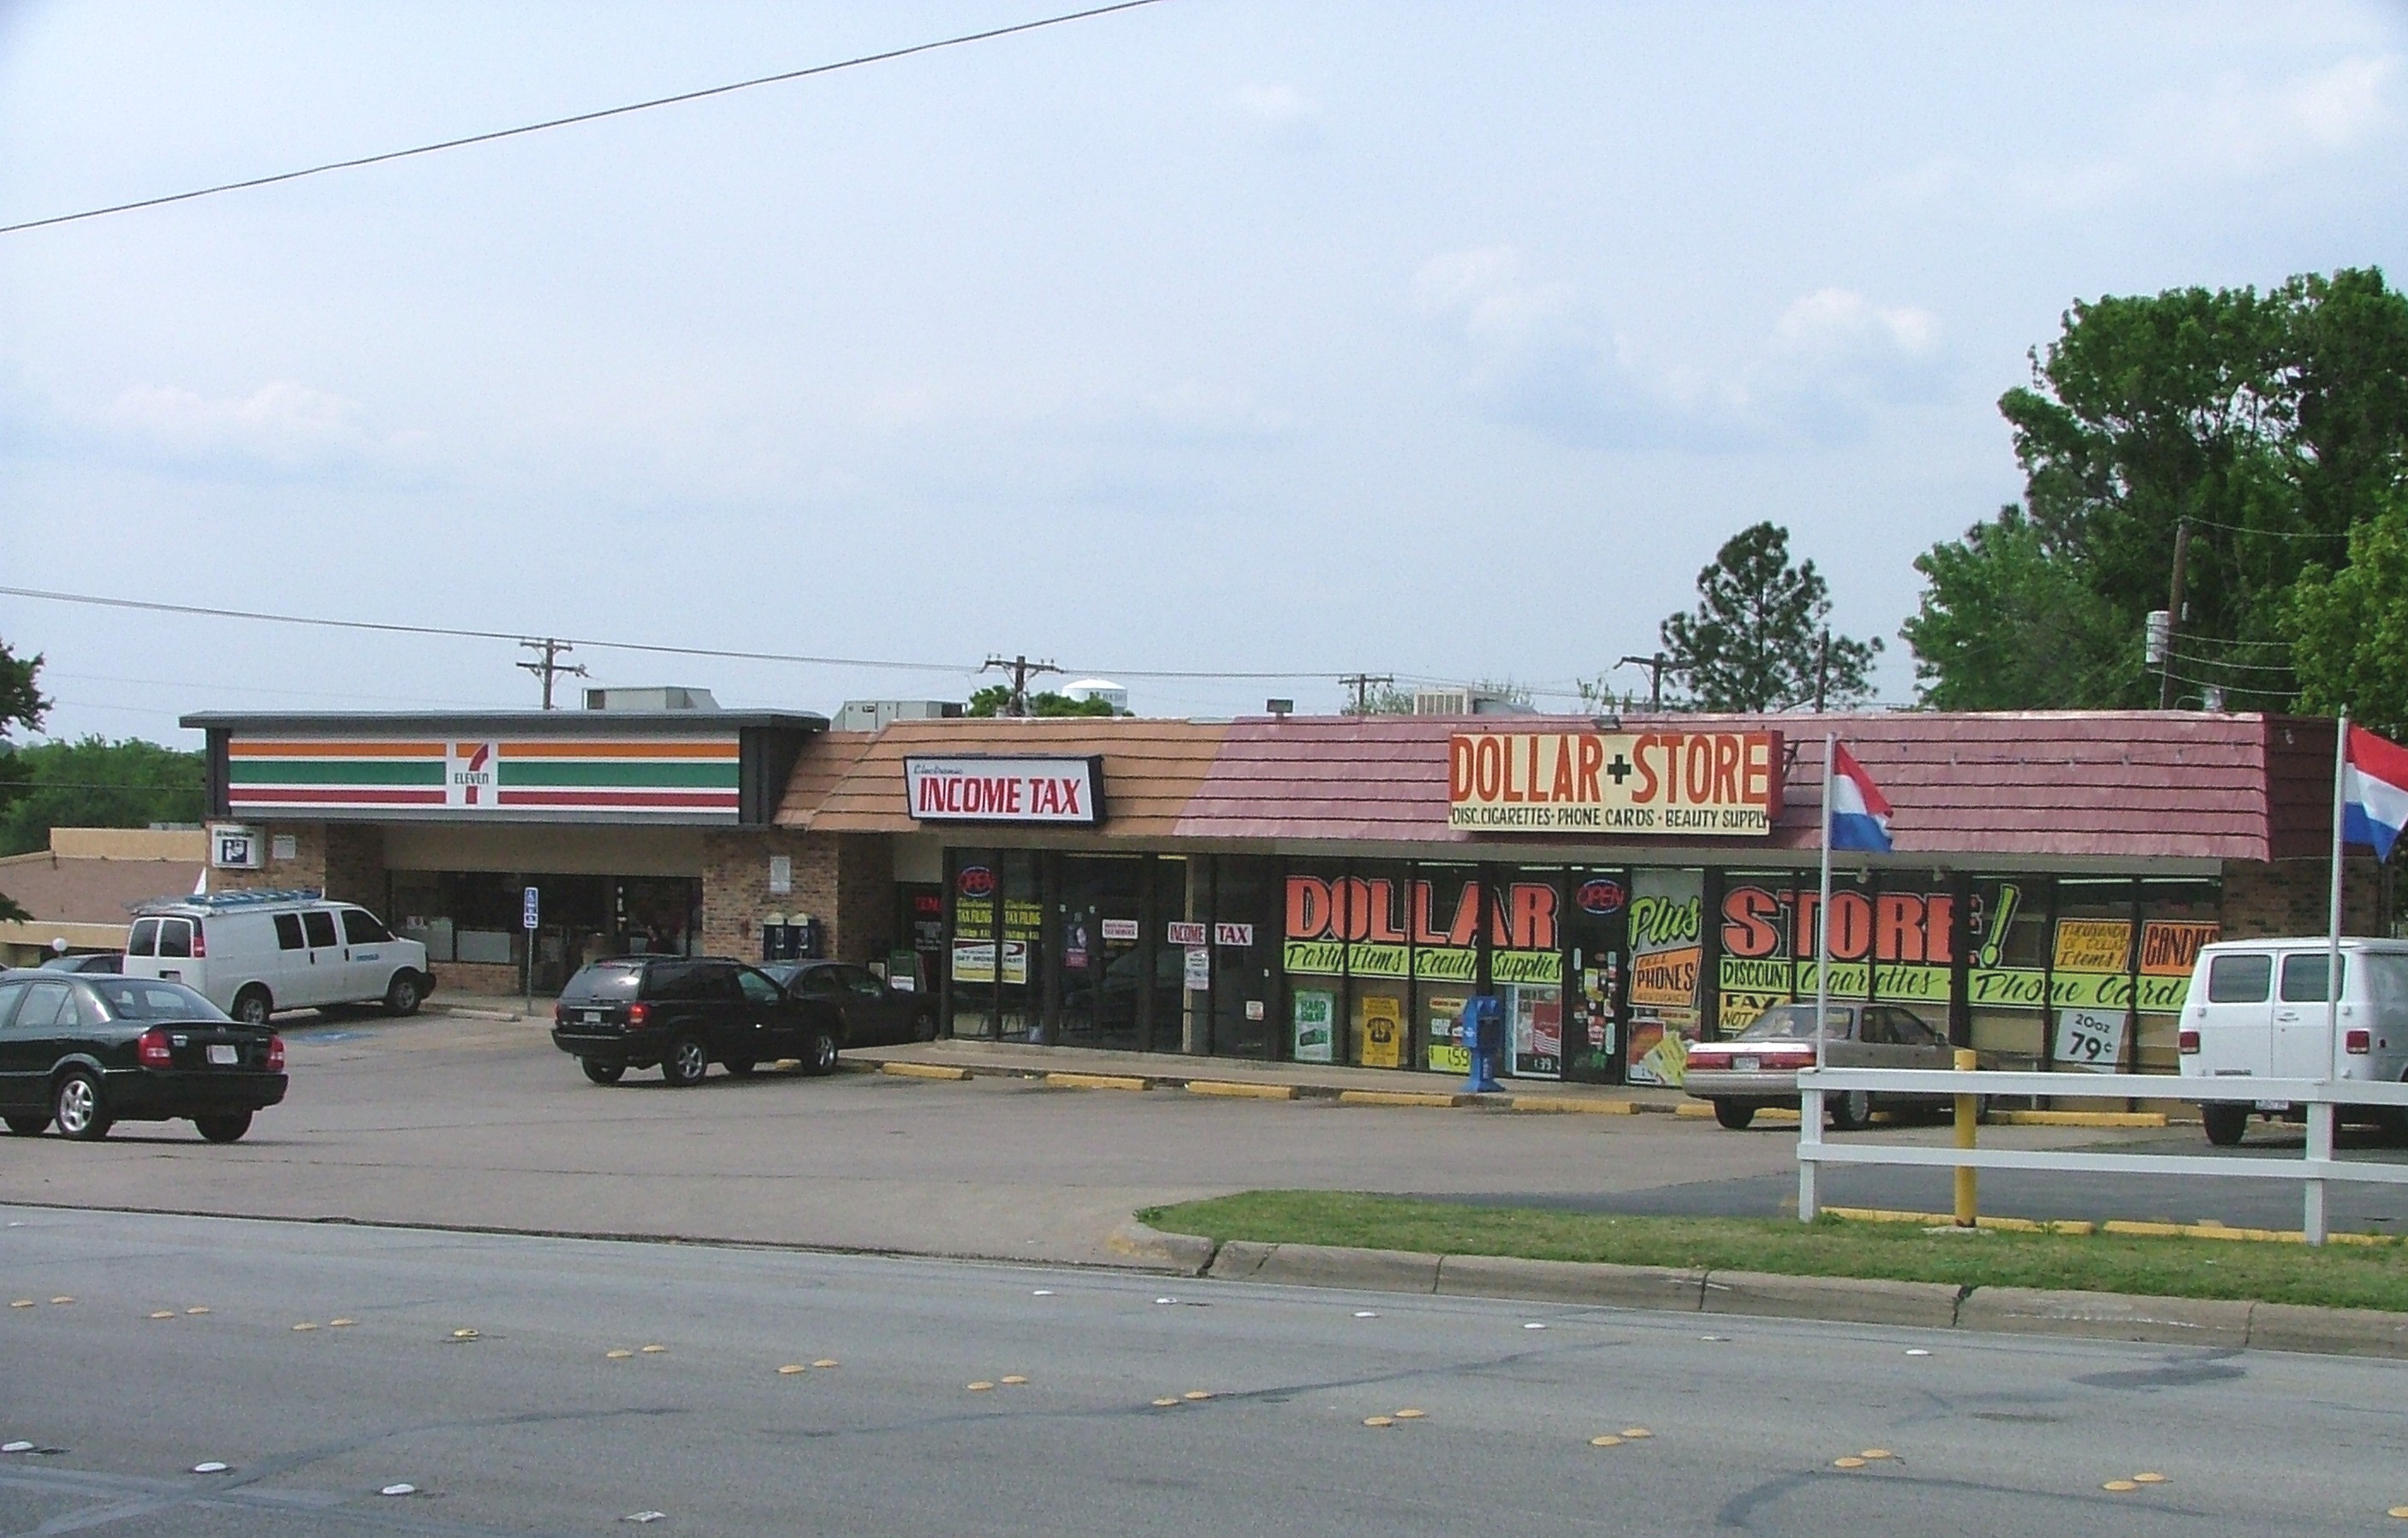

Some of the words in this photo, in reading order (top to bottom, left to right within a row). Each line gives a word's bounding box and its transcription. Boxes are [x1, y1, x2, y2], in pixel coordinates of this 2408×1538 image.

[1451, 734, 1603, 803] DOLLAR
[1632, 734, 1767, 805] STORE
[919, 777, 1022, 813] INCOME
[1029, 778, 1081, 814] TAX
[1557, 808, 1601, 827] PHONE
[1606, 809, 1654, 827] CARDS
[1666, 810, 1716, 828] BEAUTY
[1722, 811, 1767, 828] SUPPLY
[1285, 875, 1561, 949] DOLLAR
[1629, 895, 1701, 950] Plus
[1217, 925, 1248, 944] TAX
[1637, 962, 1695, 992] PHONES
[1723, 961, 1792, 986] DISCOUNT
[2096, 976, 2185, 1006] Card
